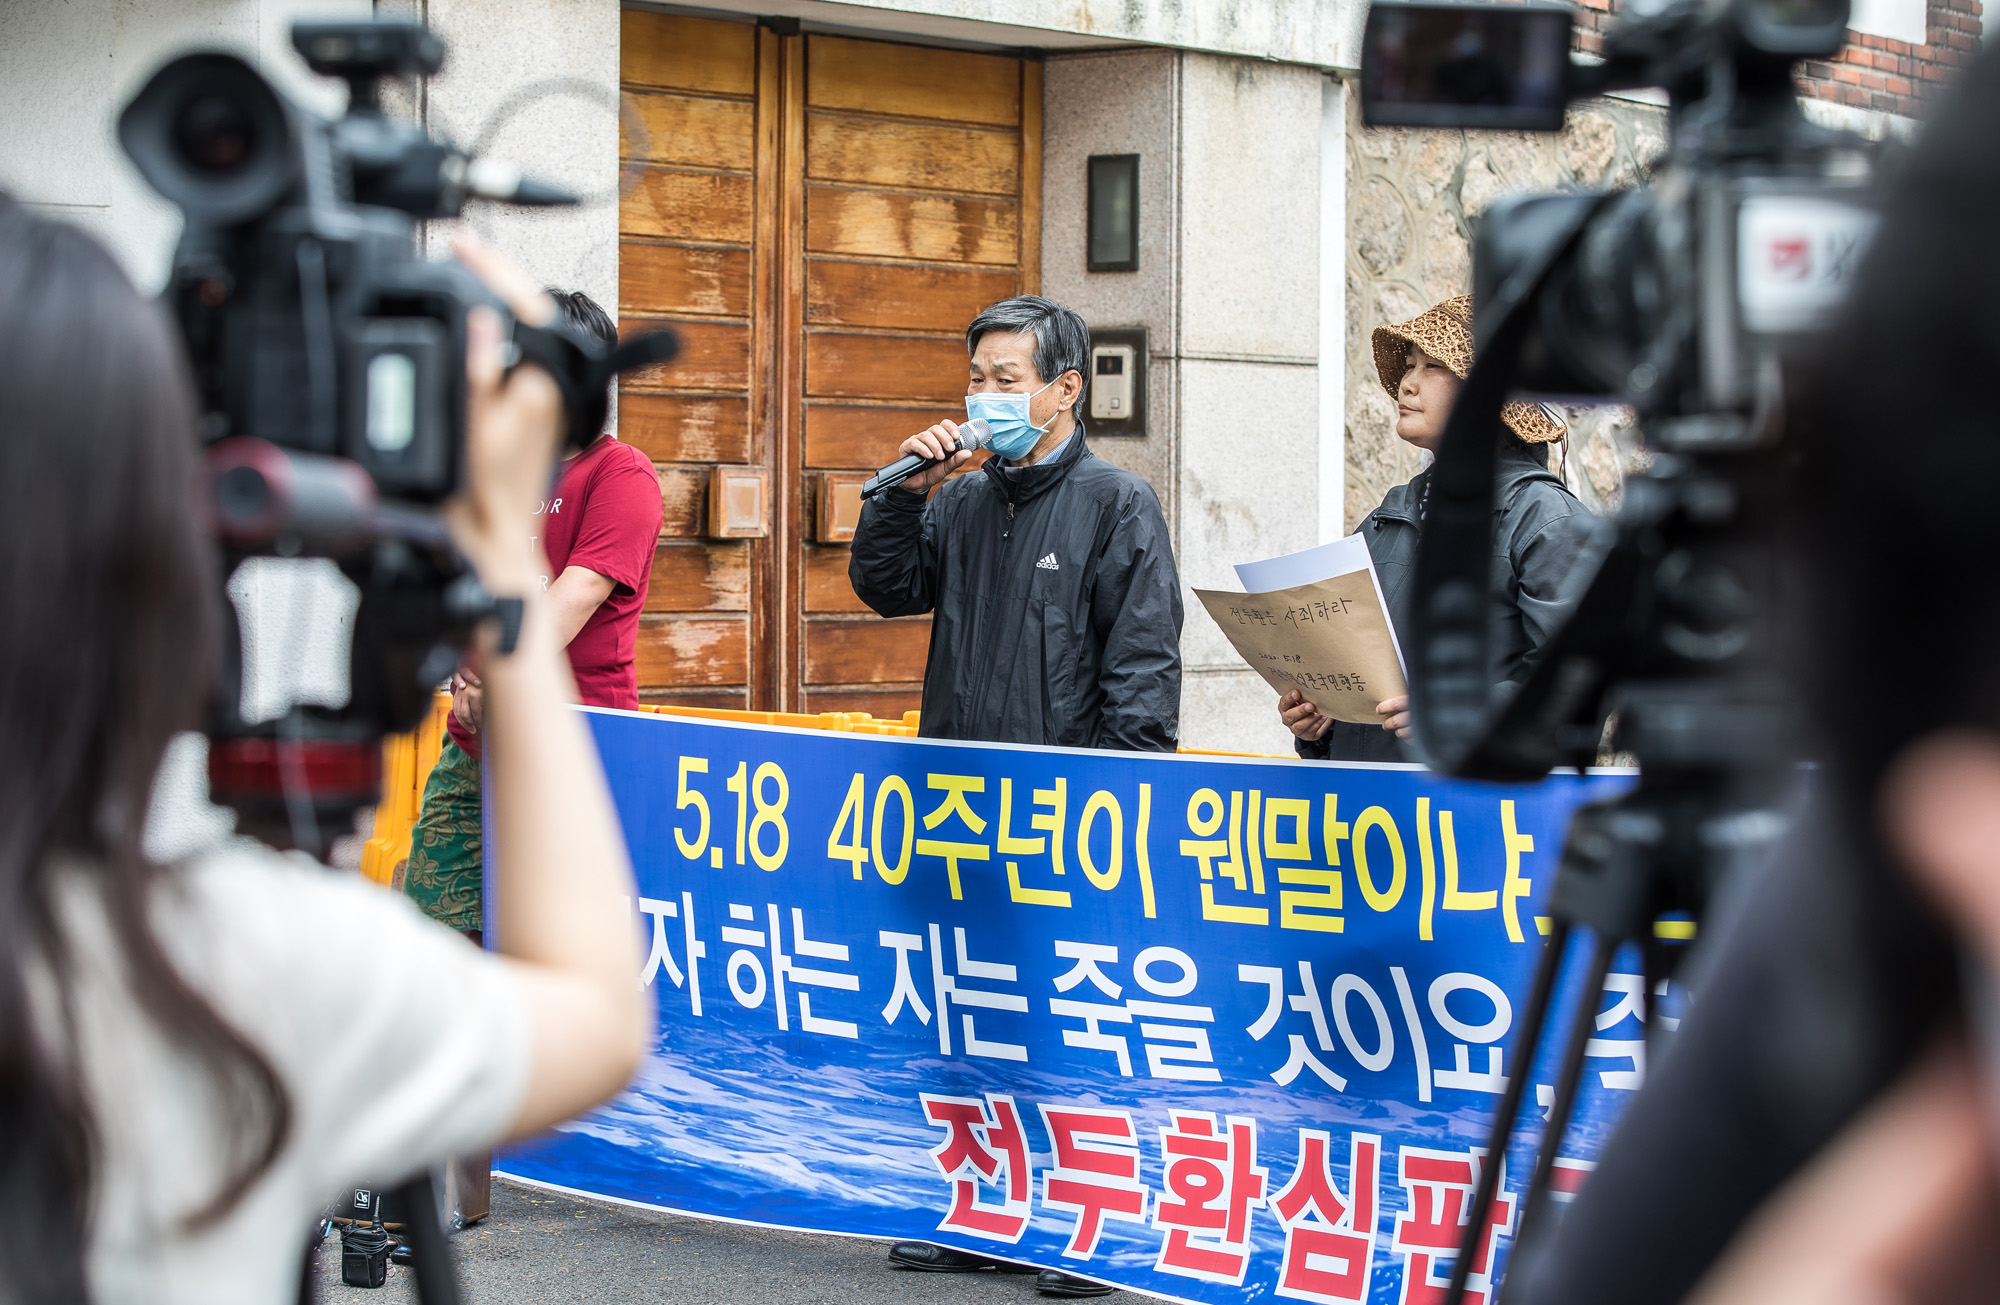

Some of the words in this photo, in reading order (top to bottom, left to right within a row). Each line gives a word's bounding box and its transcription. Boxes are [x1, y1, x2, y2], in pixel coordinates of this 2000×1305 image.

[1036, 562, 1060, 570] adidas
[1229, 607, 1278, 626] 전두환은
[1284, 597, 1353, 629] 사죄하라
[674, 755, 790, 872] 5.18
[828, 772, 1156, 919] 40주년이
[624, 890, 706, 1017] 자
[721, 903, 860, 1040] 하는
[879, 923, 1028, 1062] 자는
[1049, 939, 1222, 1083] 죽을
[1237, 960, 1556, 1123] 것이요,
